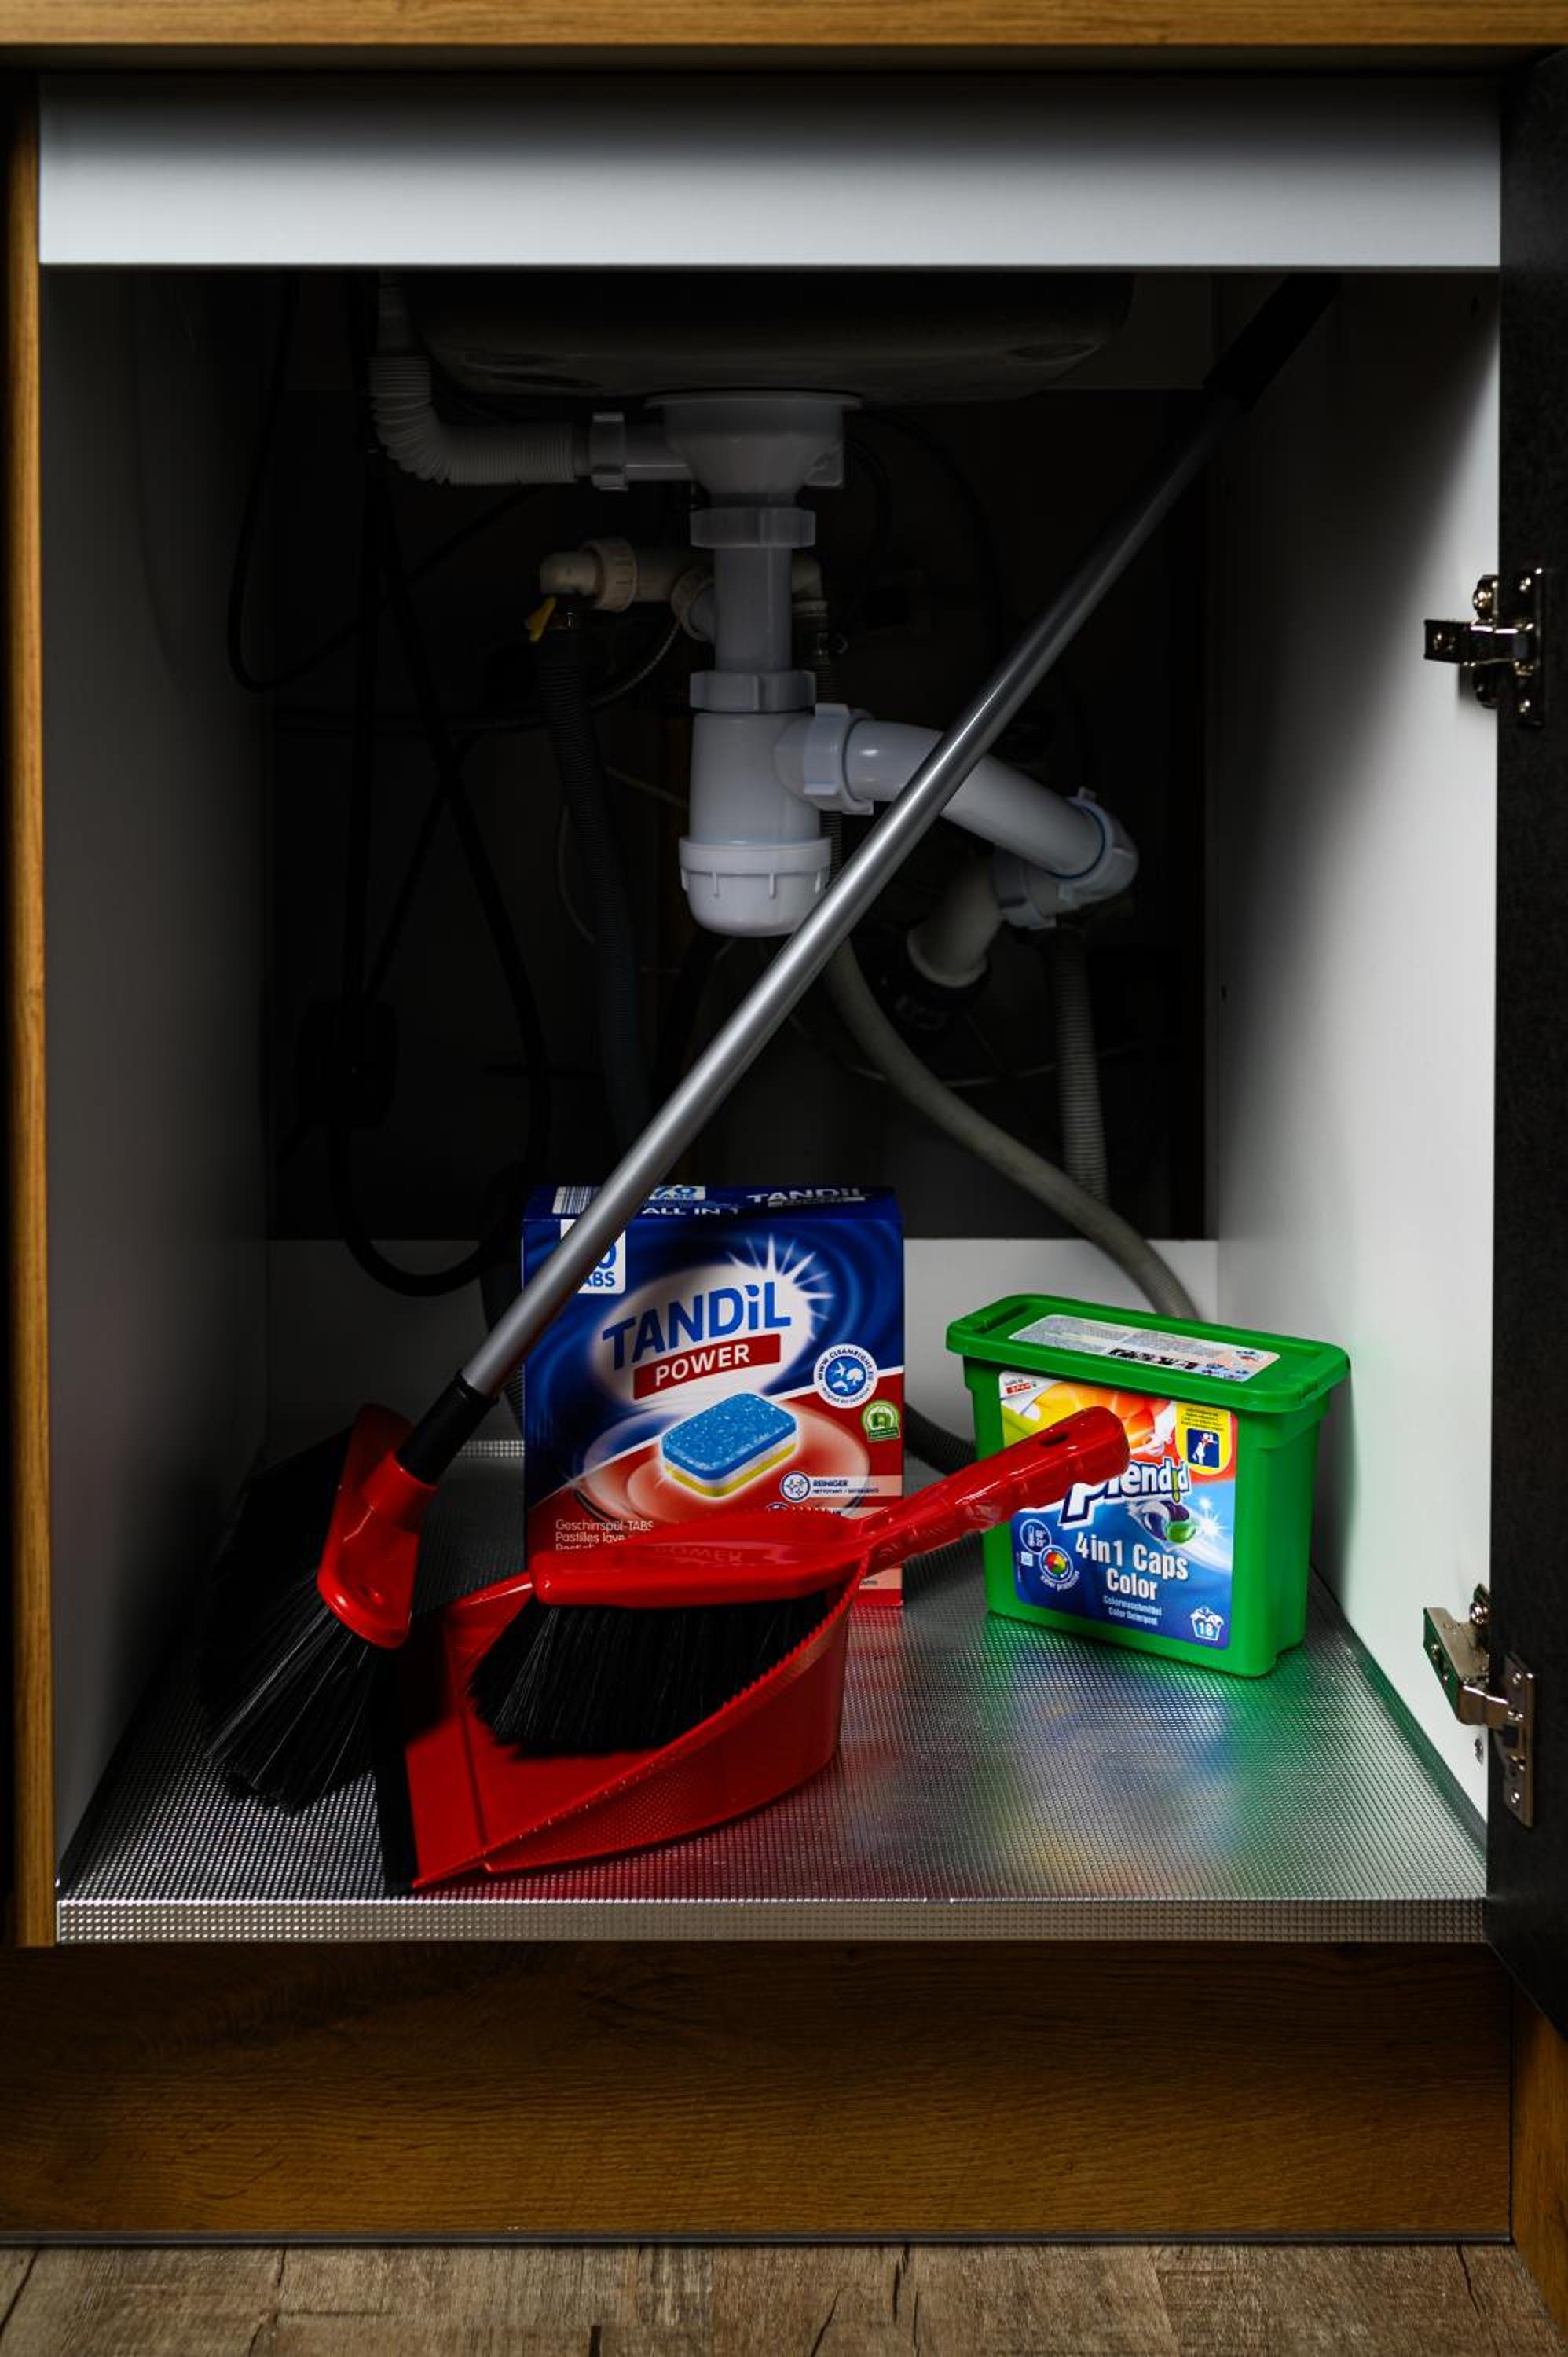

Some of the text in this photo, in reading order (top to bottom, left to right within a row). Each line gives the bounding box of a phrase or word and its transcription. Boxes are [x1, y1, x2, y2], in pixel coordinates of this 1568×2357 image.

[642, 1207, 686, 1215] ALL
[694, 1206, 720, 1215] IN
[582, 1272, 616, 1288] ABS
[654, 1343, 751, 1387] POWER
[555, 1519, 654, 1533] Geschirrspül-TABS
[555, 1532, 599, 1544] Pastilles
[1133, 1544, 1189, 1580] Caps
[1106, 1567, 1158, 1600] Color
[1108, 1607, 1126, 1618] Color
